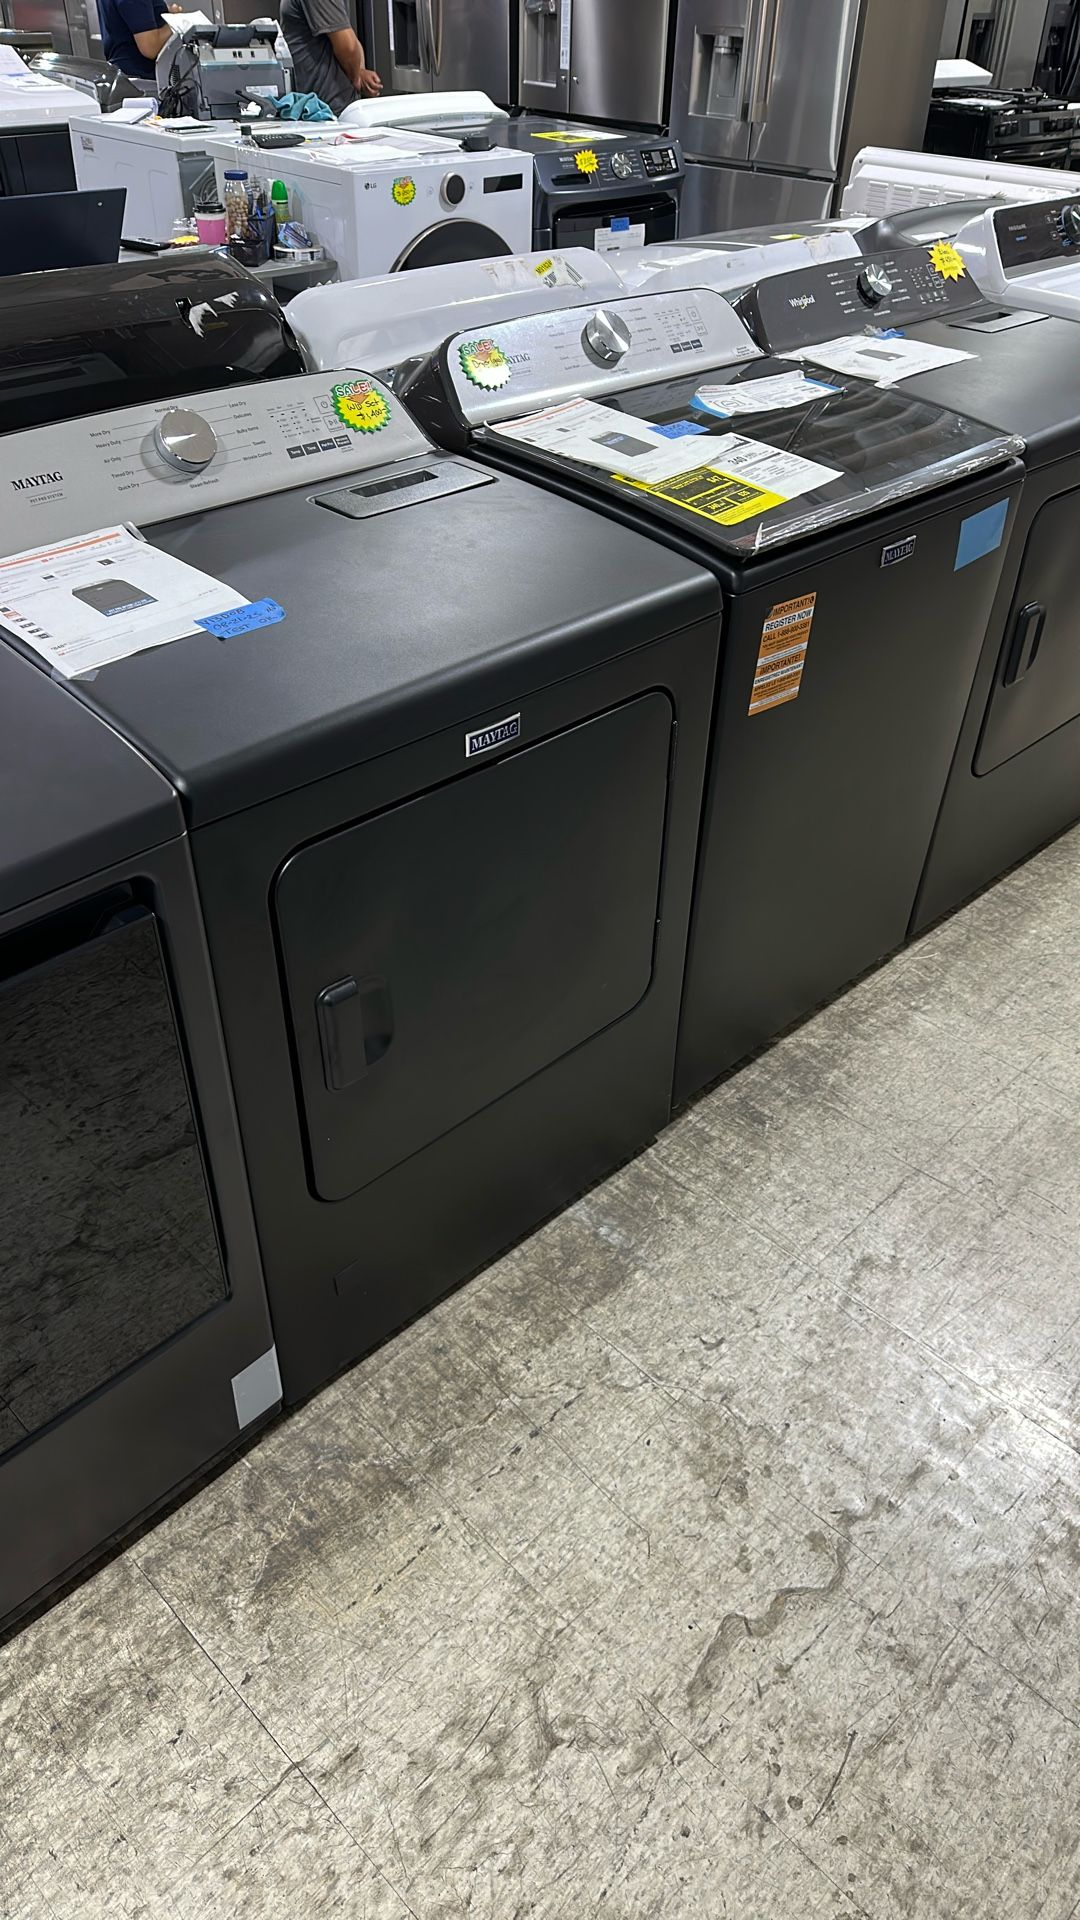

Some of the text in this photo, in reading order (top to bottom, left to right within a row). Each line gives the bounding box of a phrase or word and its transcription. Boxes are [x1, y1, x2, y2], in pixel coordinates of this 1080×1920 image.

[788, 294, 816, 309] Whirlpool
[335, 381, 373, 397] SALE!
[11, 471, 63, 491] MAYTAG
[765, 614, 797, 631] REGISTER
[797, 609, 813, 620] NOW
[763, 633, 776, 642] CALL
[471, 721, 517, 751] MAYTAG
